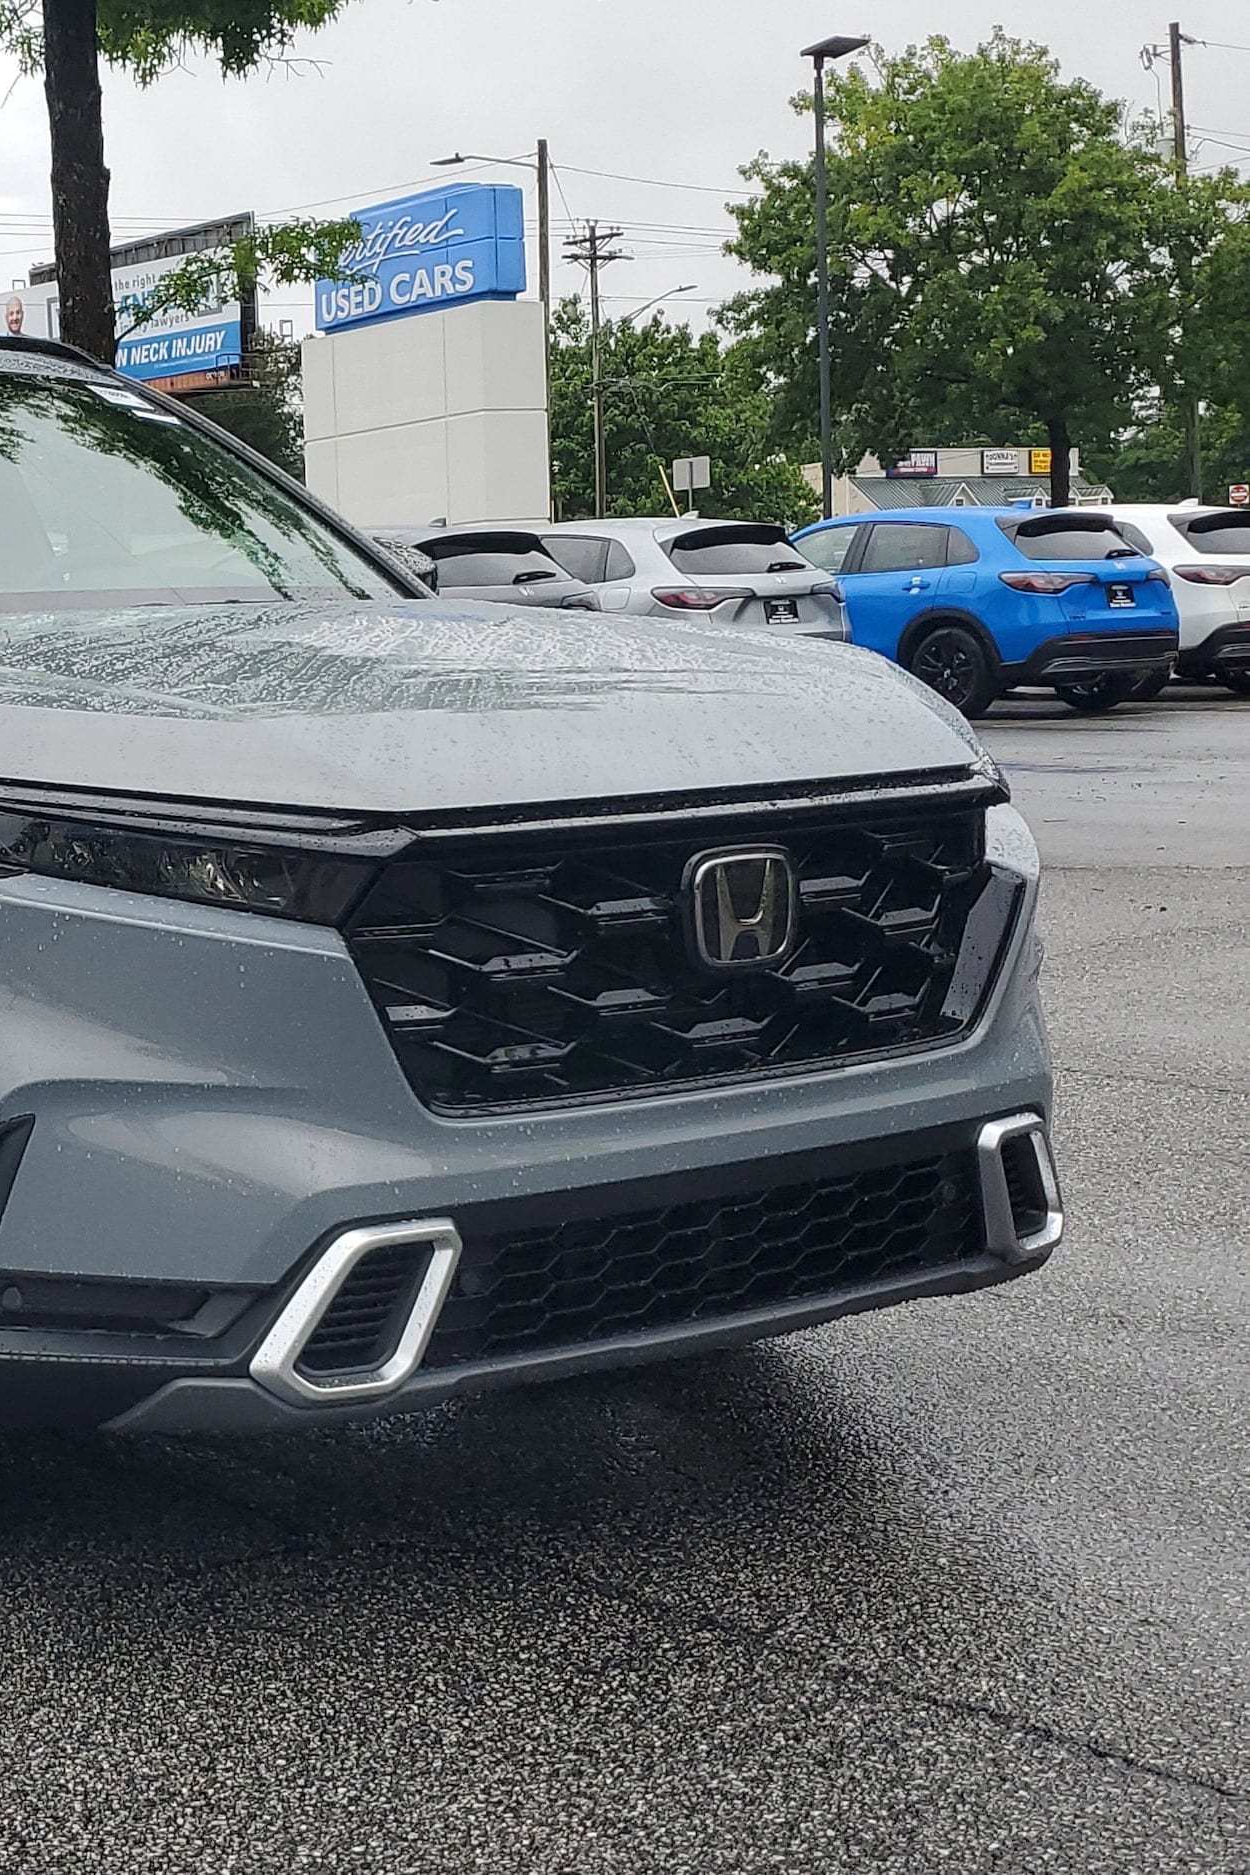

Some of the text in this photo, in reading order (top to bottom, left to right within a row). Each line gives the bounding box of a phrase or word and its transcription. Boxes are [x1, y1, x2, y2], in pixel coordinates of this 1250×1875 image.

[335, 208, 465, 274] ertified
[114, 278, 130, 291] the
[132, 273, 156, 289] right
[322, 260, 474, 323] USED CARS
[151, 313, 190, 329] lawyers
[115, 347, 128, 368] N
[130, 341, 170, 365] NECK
[171, 330, 226, 358] INJURY
